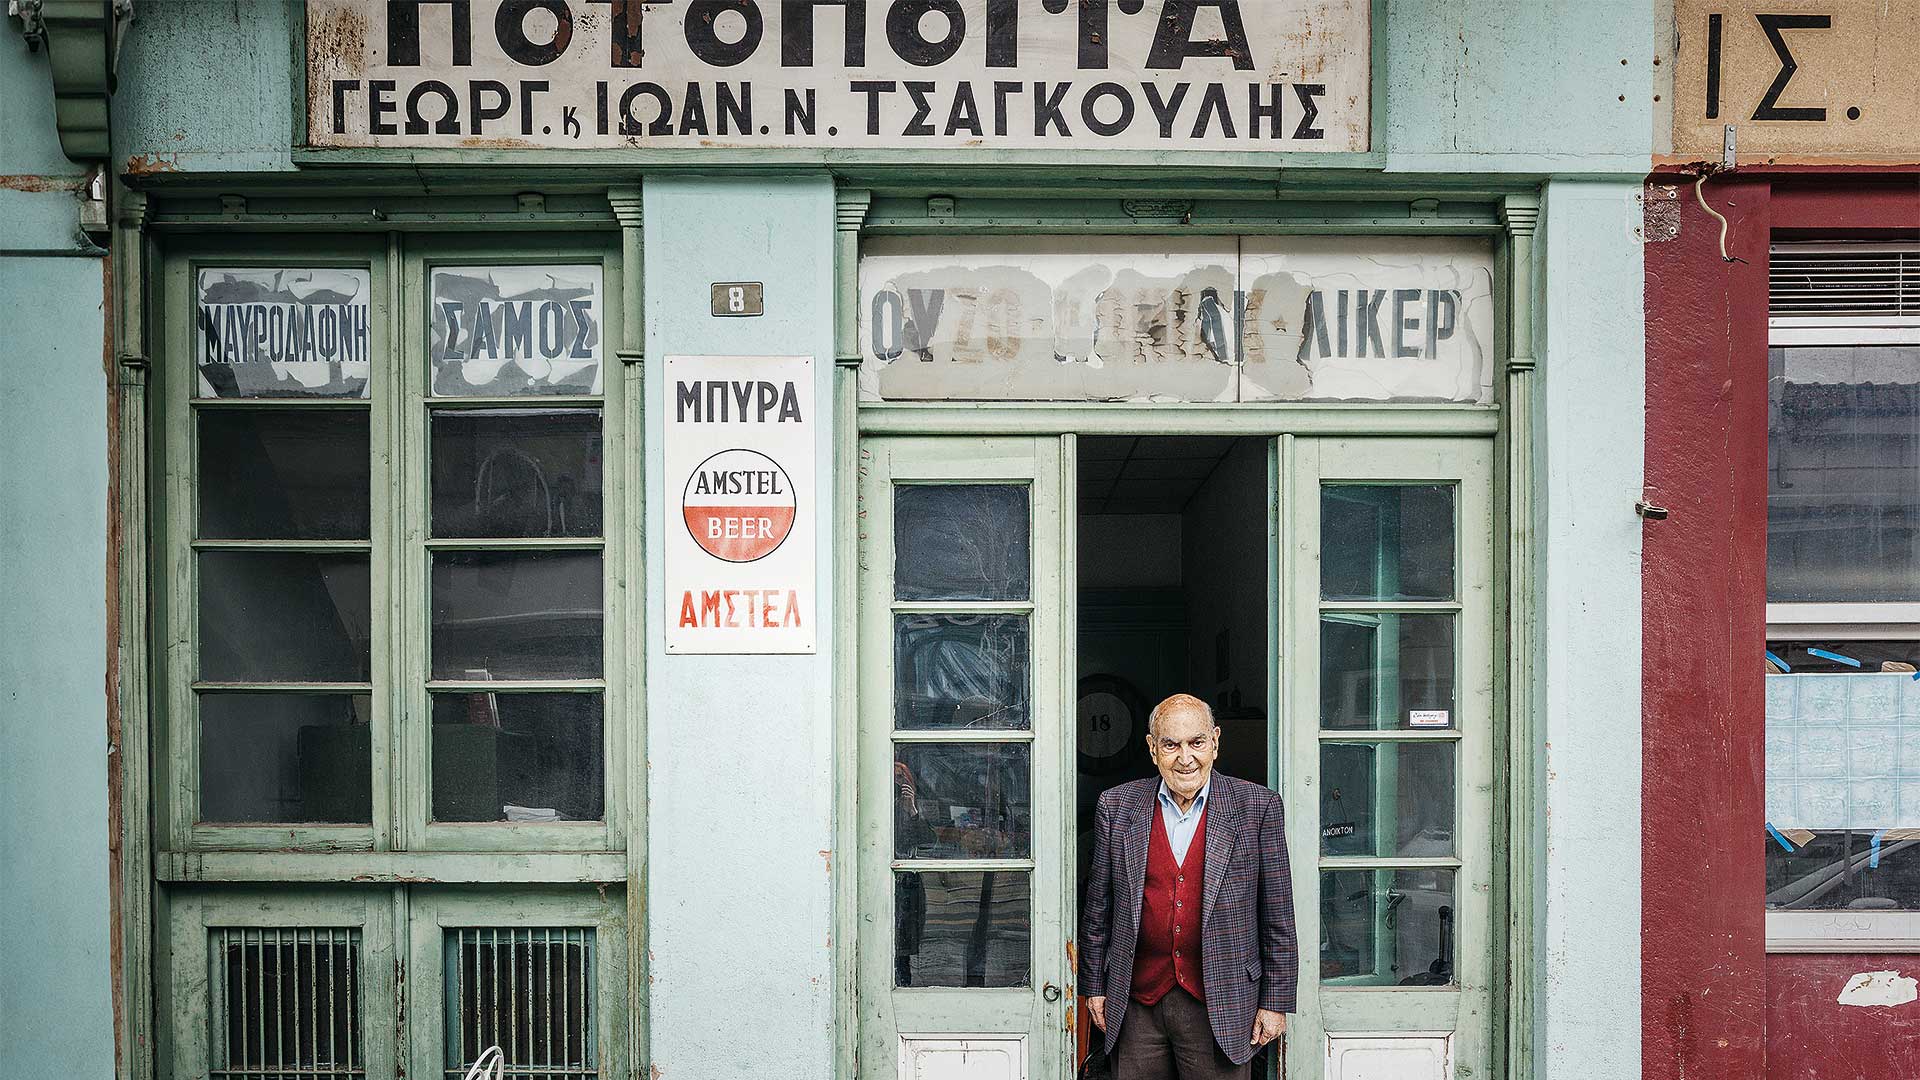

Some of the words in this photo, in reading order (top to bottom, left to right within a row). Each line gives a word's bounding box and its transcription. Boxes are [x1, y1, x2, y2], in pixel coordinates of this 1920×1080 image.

[332, 79, 551, 136] ΓΕΩΡΓ.
[596, 80, 769, 137] ΙΩΑΝ.
[784, 88, 838, 137] Ν.
[850, 80, 1326, 140] ΤΣΑΓΚΟΥΛΗΣ
[728, 286, 745, 313] 8
[204, 303, 368, 363] ΜΑΥΡΟΔΑΦΝΗ
[441, 299, 593, 361] ΣΑΜΟΣ
[1296, 288, 1462, 361] ΛΙΚΕΡ
[676, 380, 803, 423] ΜΠΥΡΑ
[694, 470, 783, 496] AMSTEL
[706, 516, 775, 540] BEER
[679, 589, 802, 628] ΑΜΣΤΕΛ
[1090, 713, 1111, 732] 18
